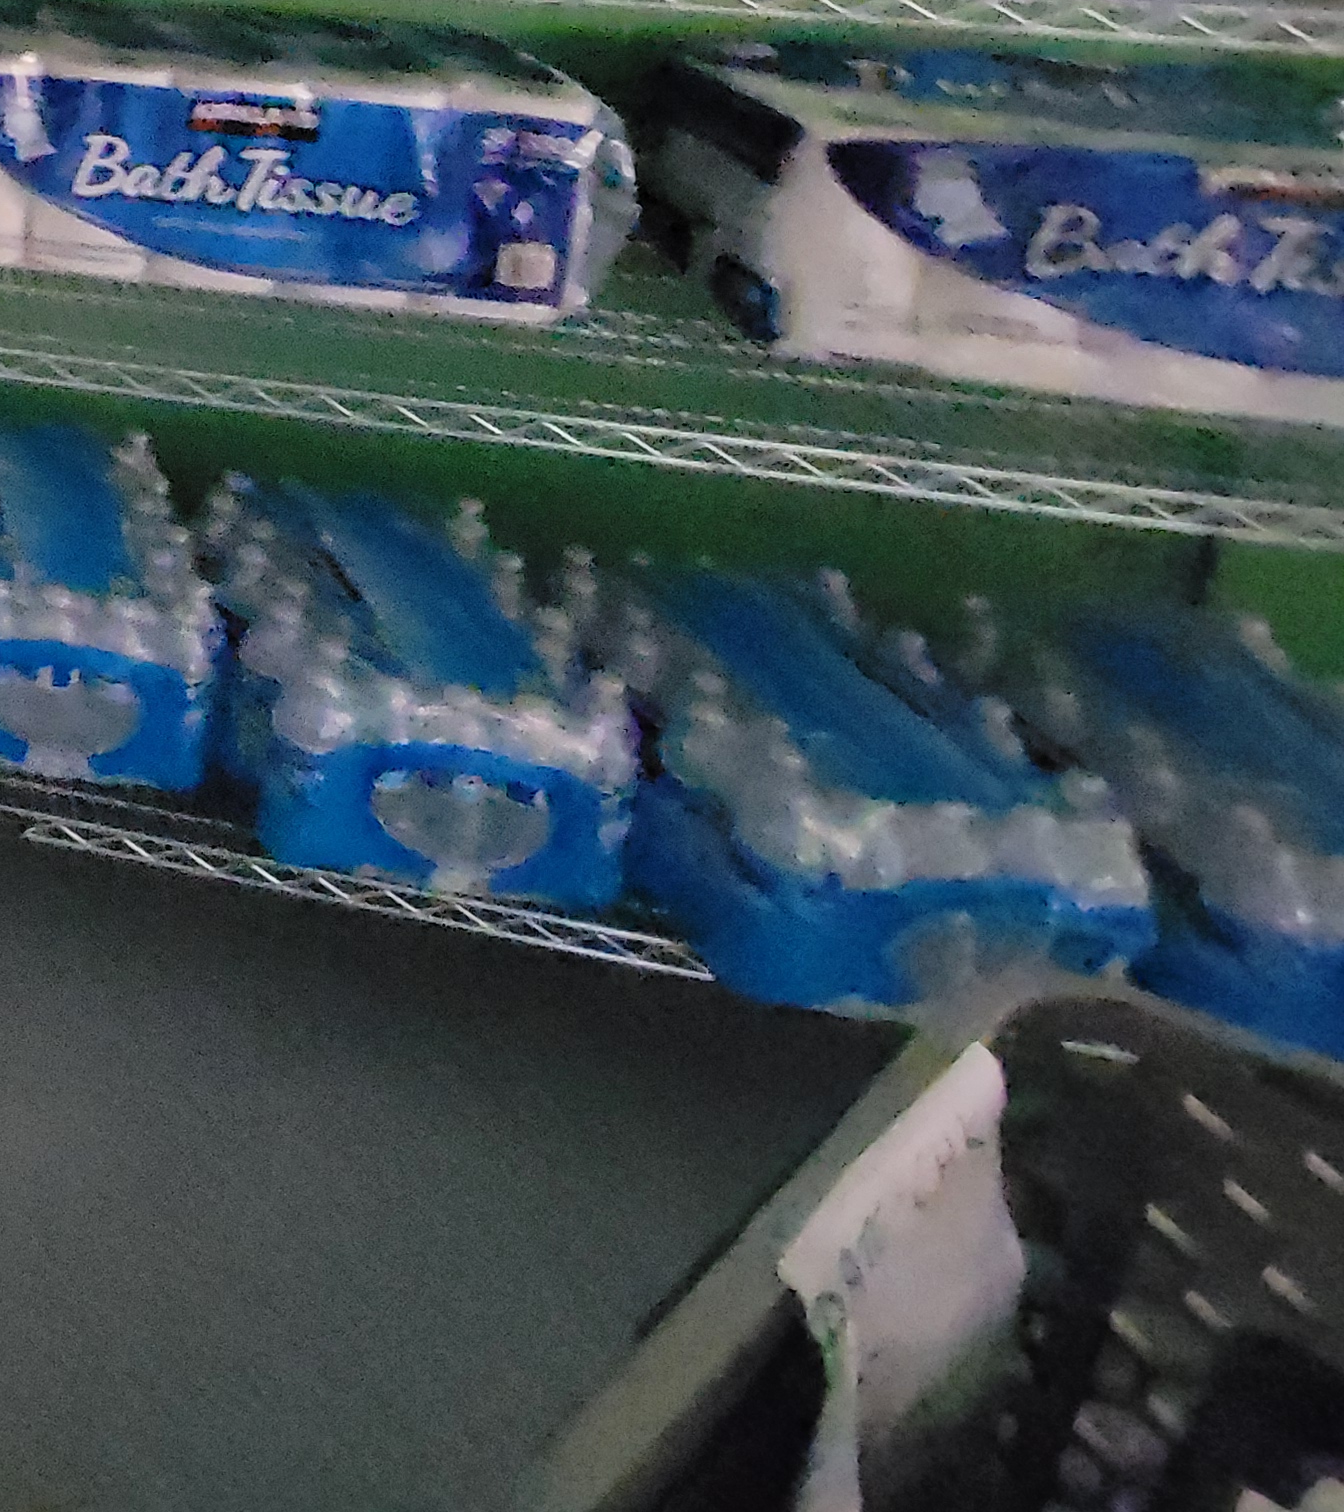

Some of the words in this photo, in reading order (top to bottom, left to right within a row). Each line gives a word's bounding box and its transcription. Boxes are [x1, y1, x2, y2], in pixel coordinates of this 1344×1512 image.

[71, 133, 236, 204] Bath
[236, 146, 420, 226] Tissue
[1025, 205, 1242, 286] Bath
